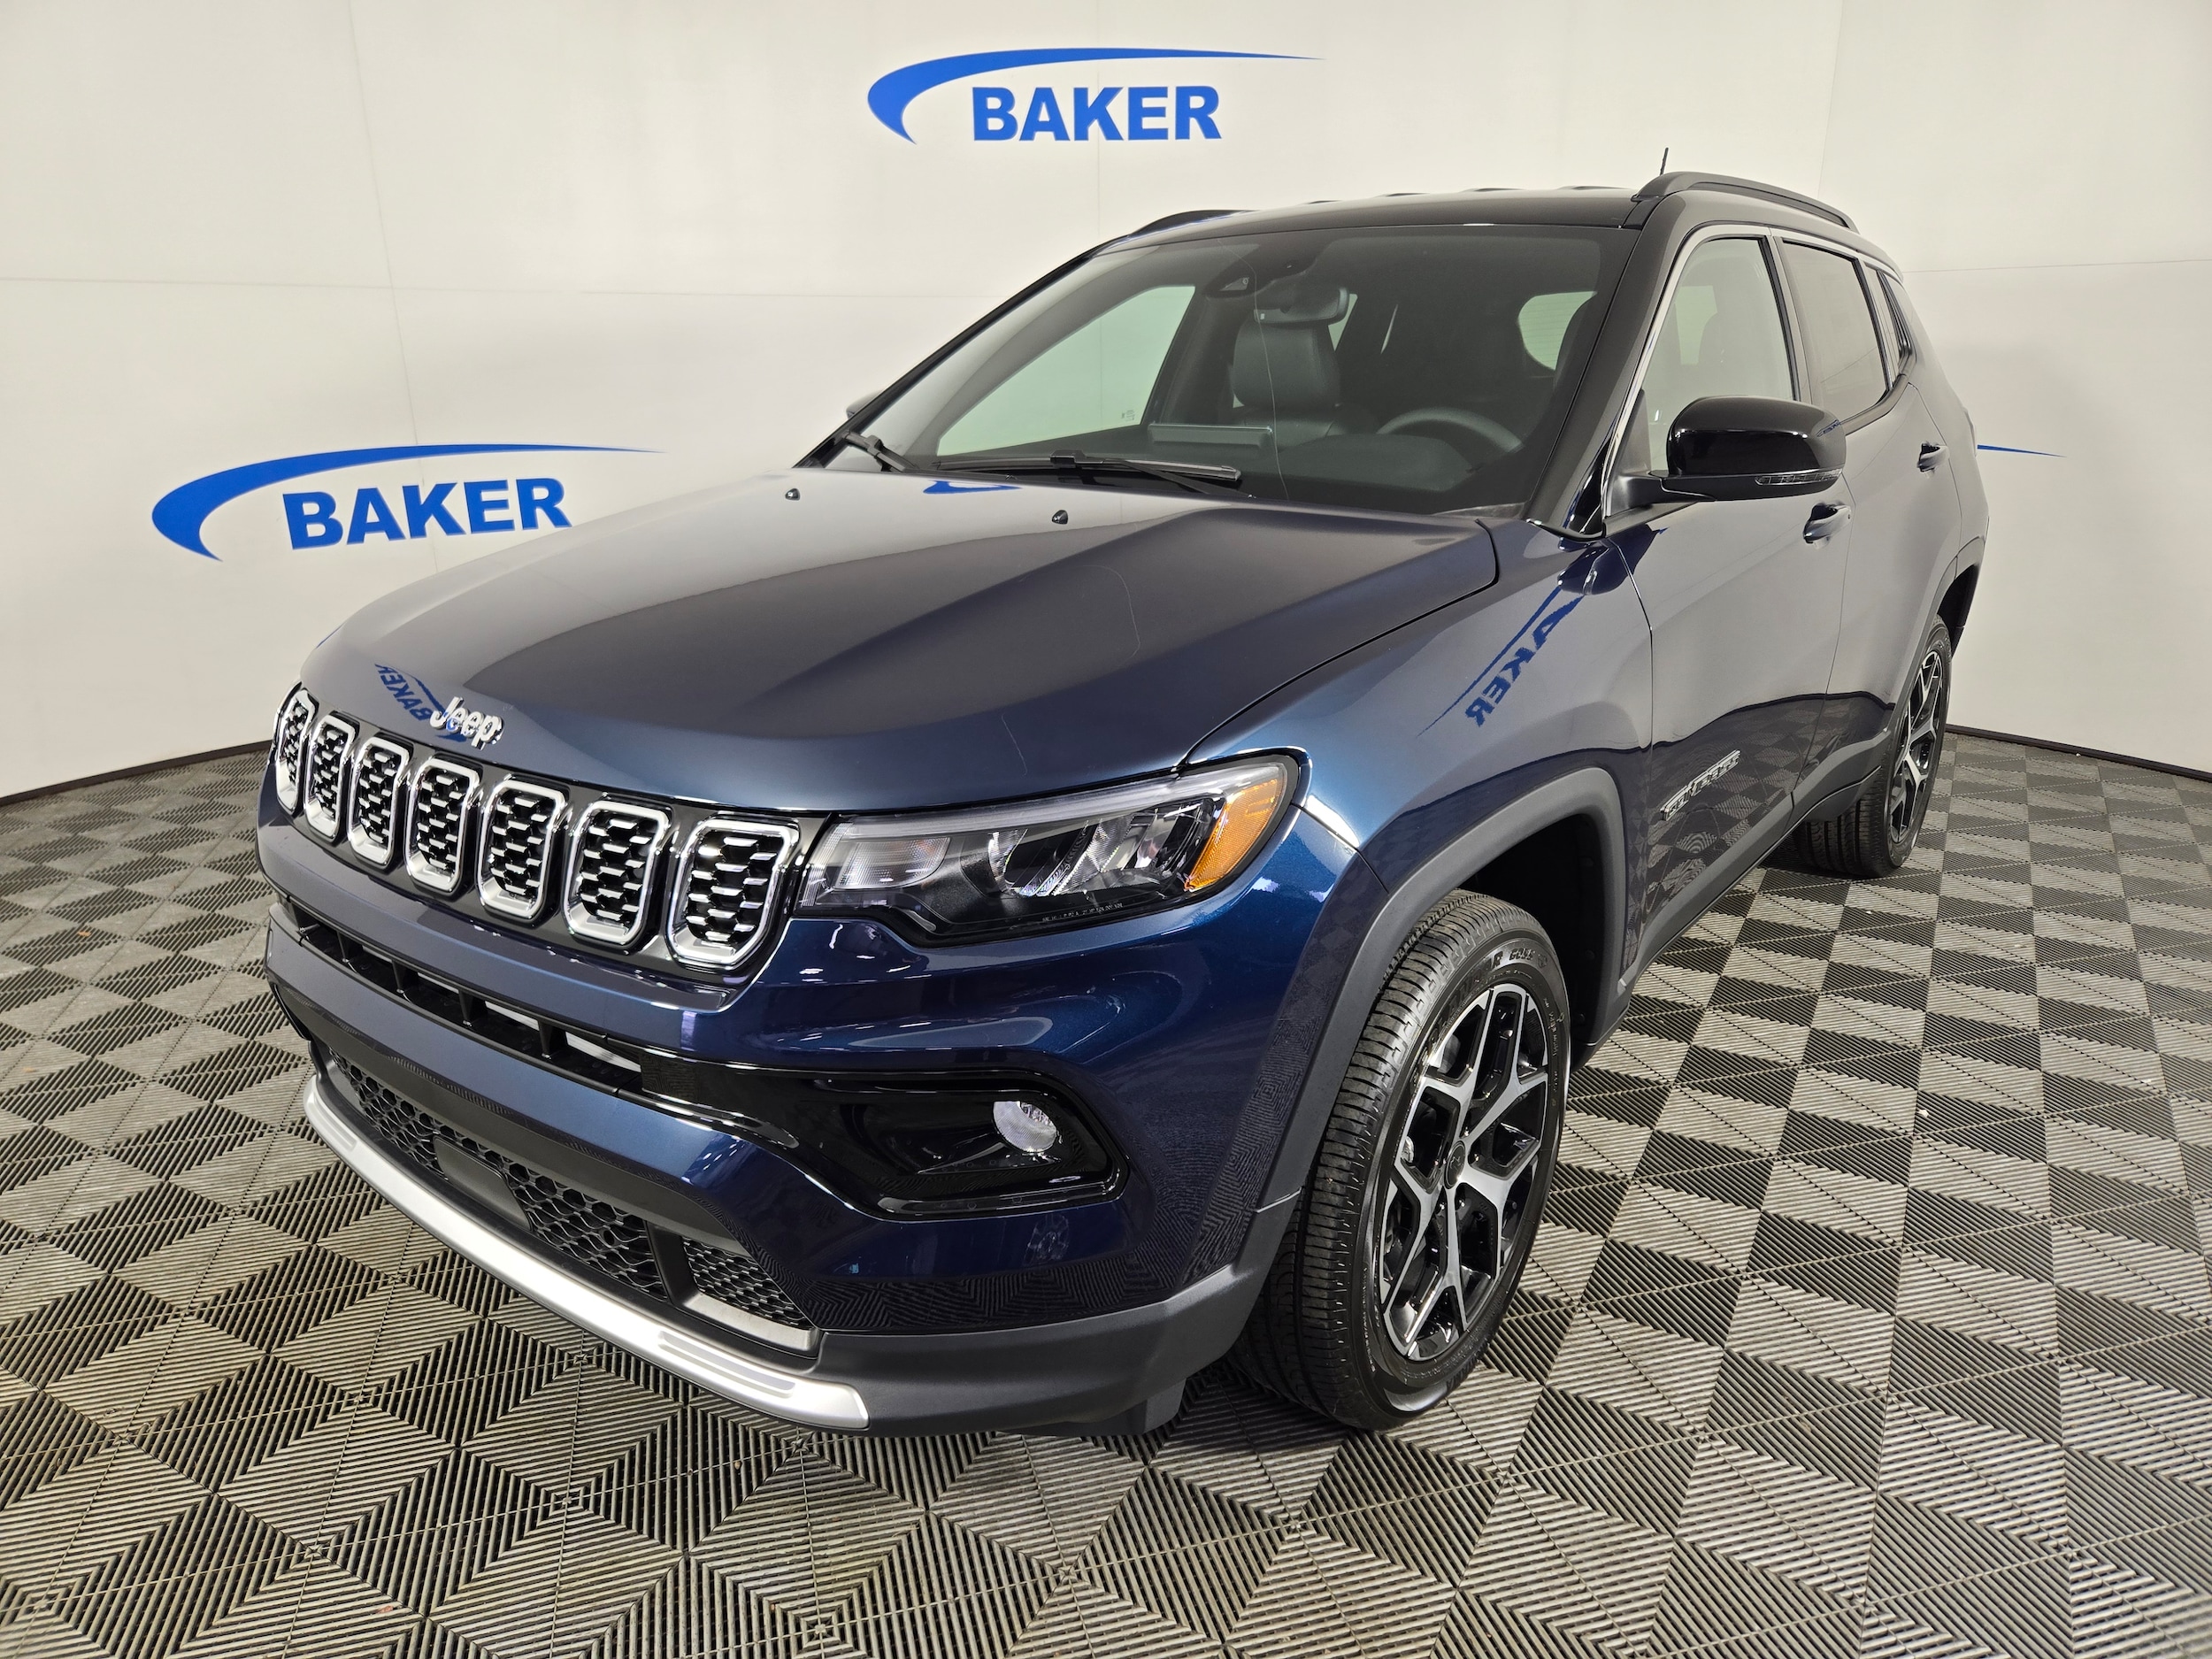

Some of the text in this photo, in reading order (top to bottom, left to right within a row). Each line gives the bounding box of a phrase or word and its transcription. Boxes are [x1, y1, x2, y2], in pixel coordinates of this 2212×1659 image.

[972, 86, 1222, 142] BAKER
[282, 478, 572, 550] BAKER
[429, 696, 504, 750] Jeep
